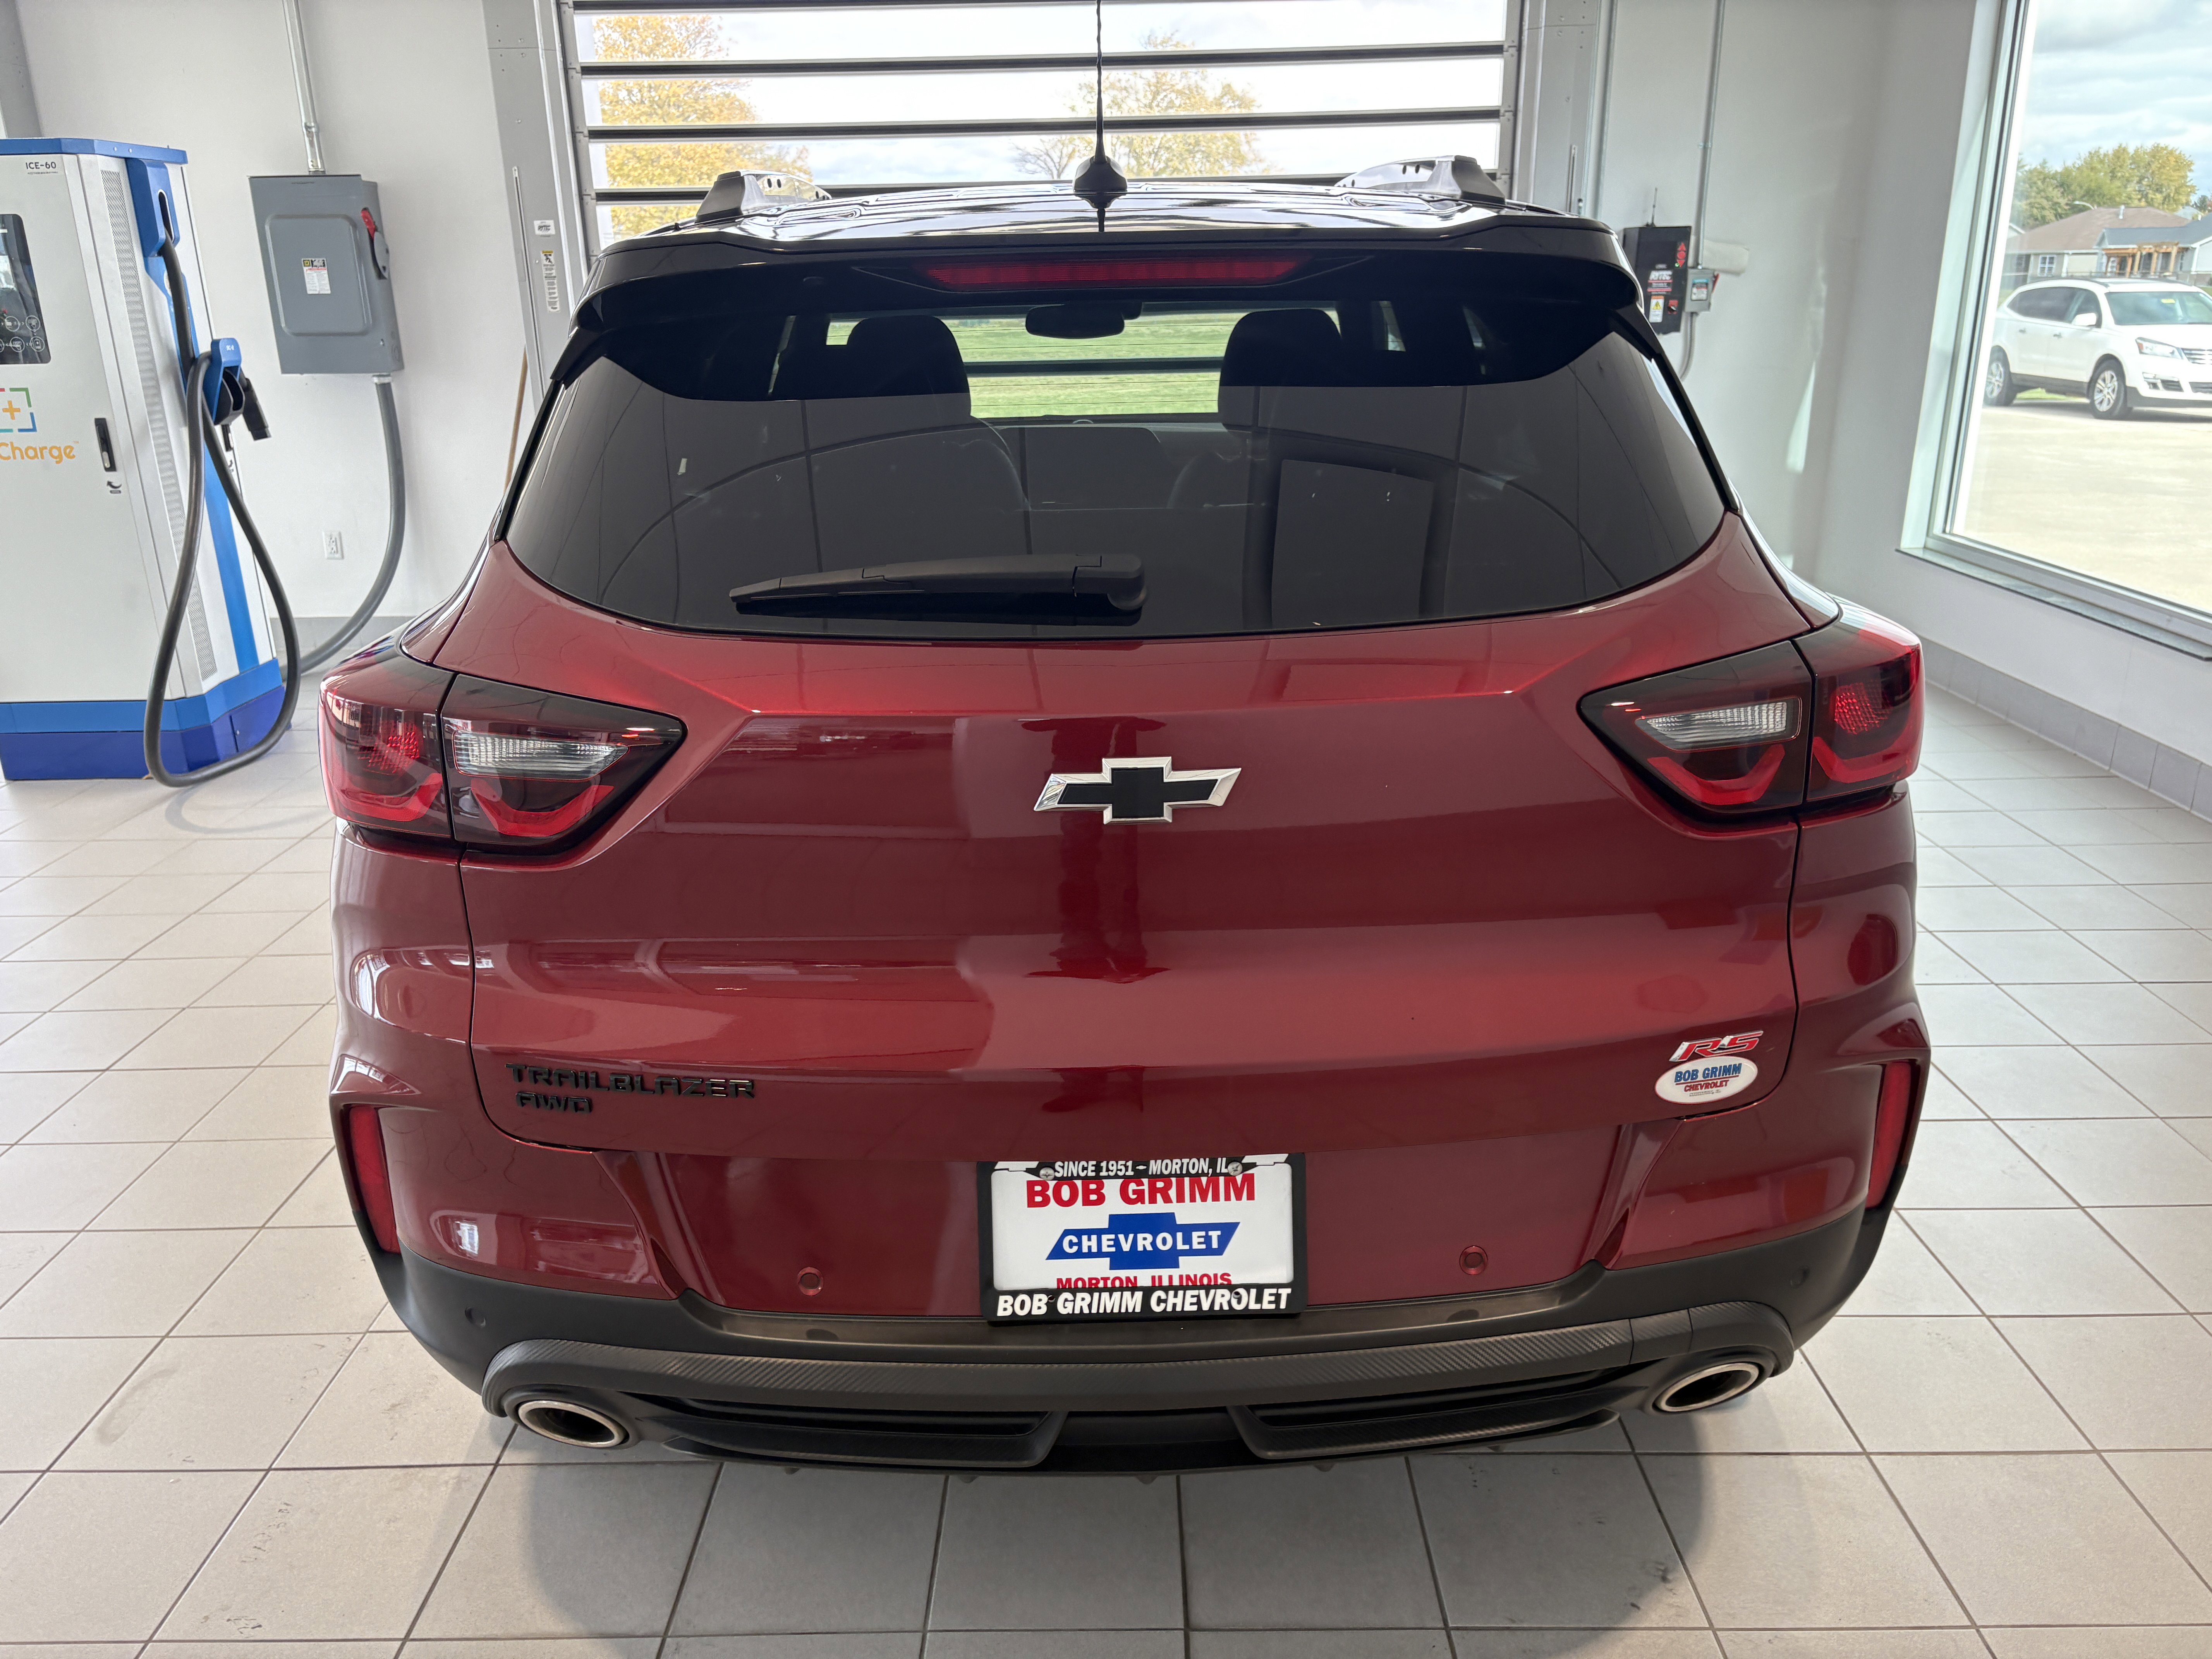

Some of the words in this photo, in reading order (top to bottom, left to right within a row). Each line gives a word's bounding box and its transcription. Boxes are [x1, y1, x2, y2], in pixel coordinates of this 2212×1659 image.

[26, 161, 57, 170] ICE-60
[0, 441, 76, 464] Charge
[1669, 1030, 1764, 1062] RS
[505, 1063, 756, 1099] TRAILBLAZER
[1674, 1070, 1699, 1083] BOB
[1702, 1063, 1742, 1078] GRIMM
[1684, 1079, 1729, 1092] CHEVROLET
[516, 1091, 592, 1114] AWD
[1054, 1161, 1097, 1177] SINCE
[1099, 1160, 1134, 1176] 1951
[1148, 1158, 1212, 1177] MORTON,
[1216, 1157, 1228, 1173] IL
[1026, 1179, 1106, 1208] BOB
[1119, 1173, 1255, 1206] GRIMM
[1063, 1230, 1221, 1254] CHEVROLET
[1056, 1276, 1138, 1289] MORTON
[997, 1293, 1048, 1316] BOB
[1056, 1291, 1143, 1315] GRIMM
[1150, 1288, 1292, 1312] CHEVROLET
